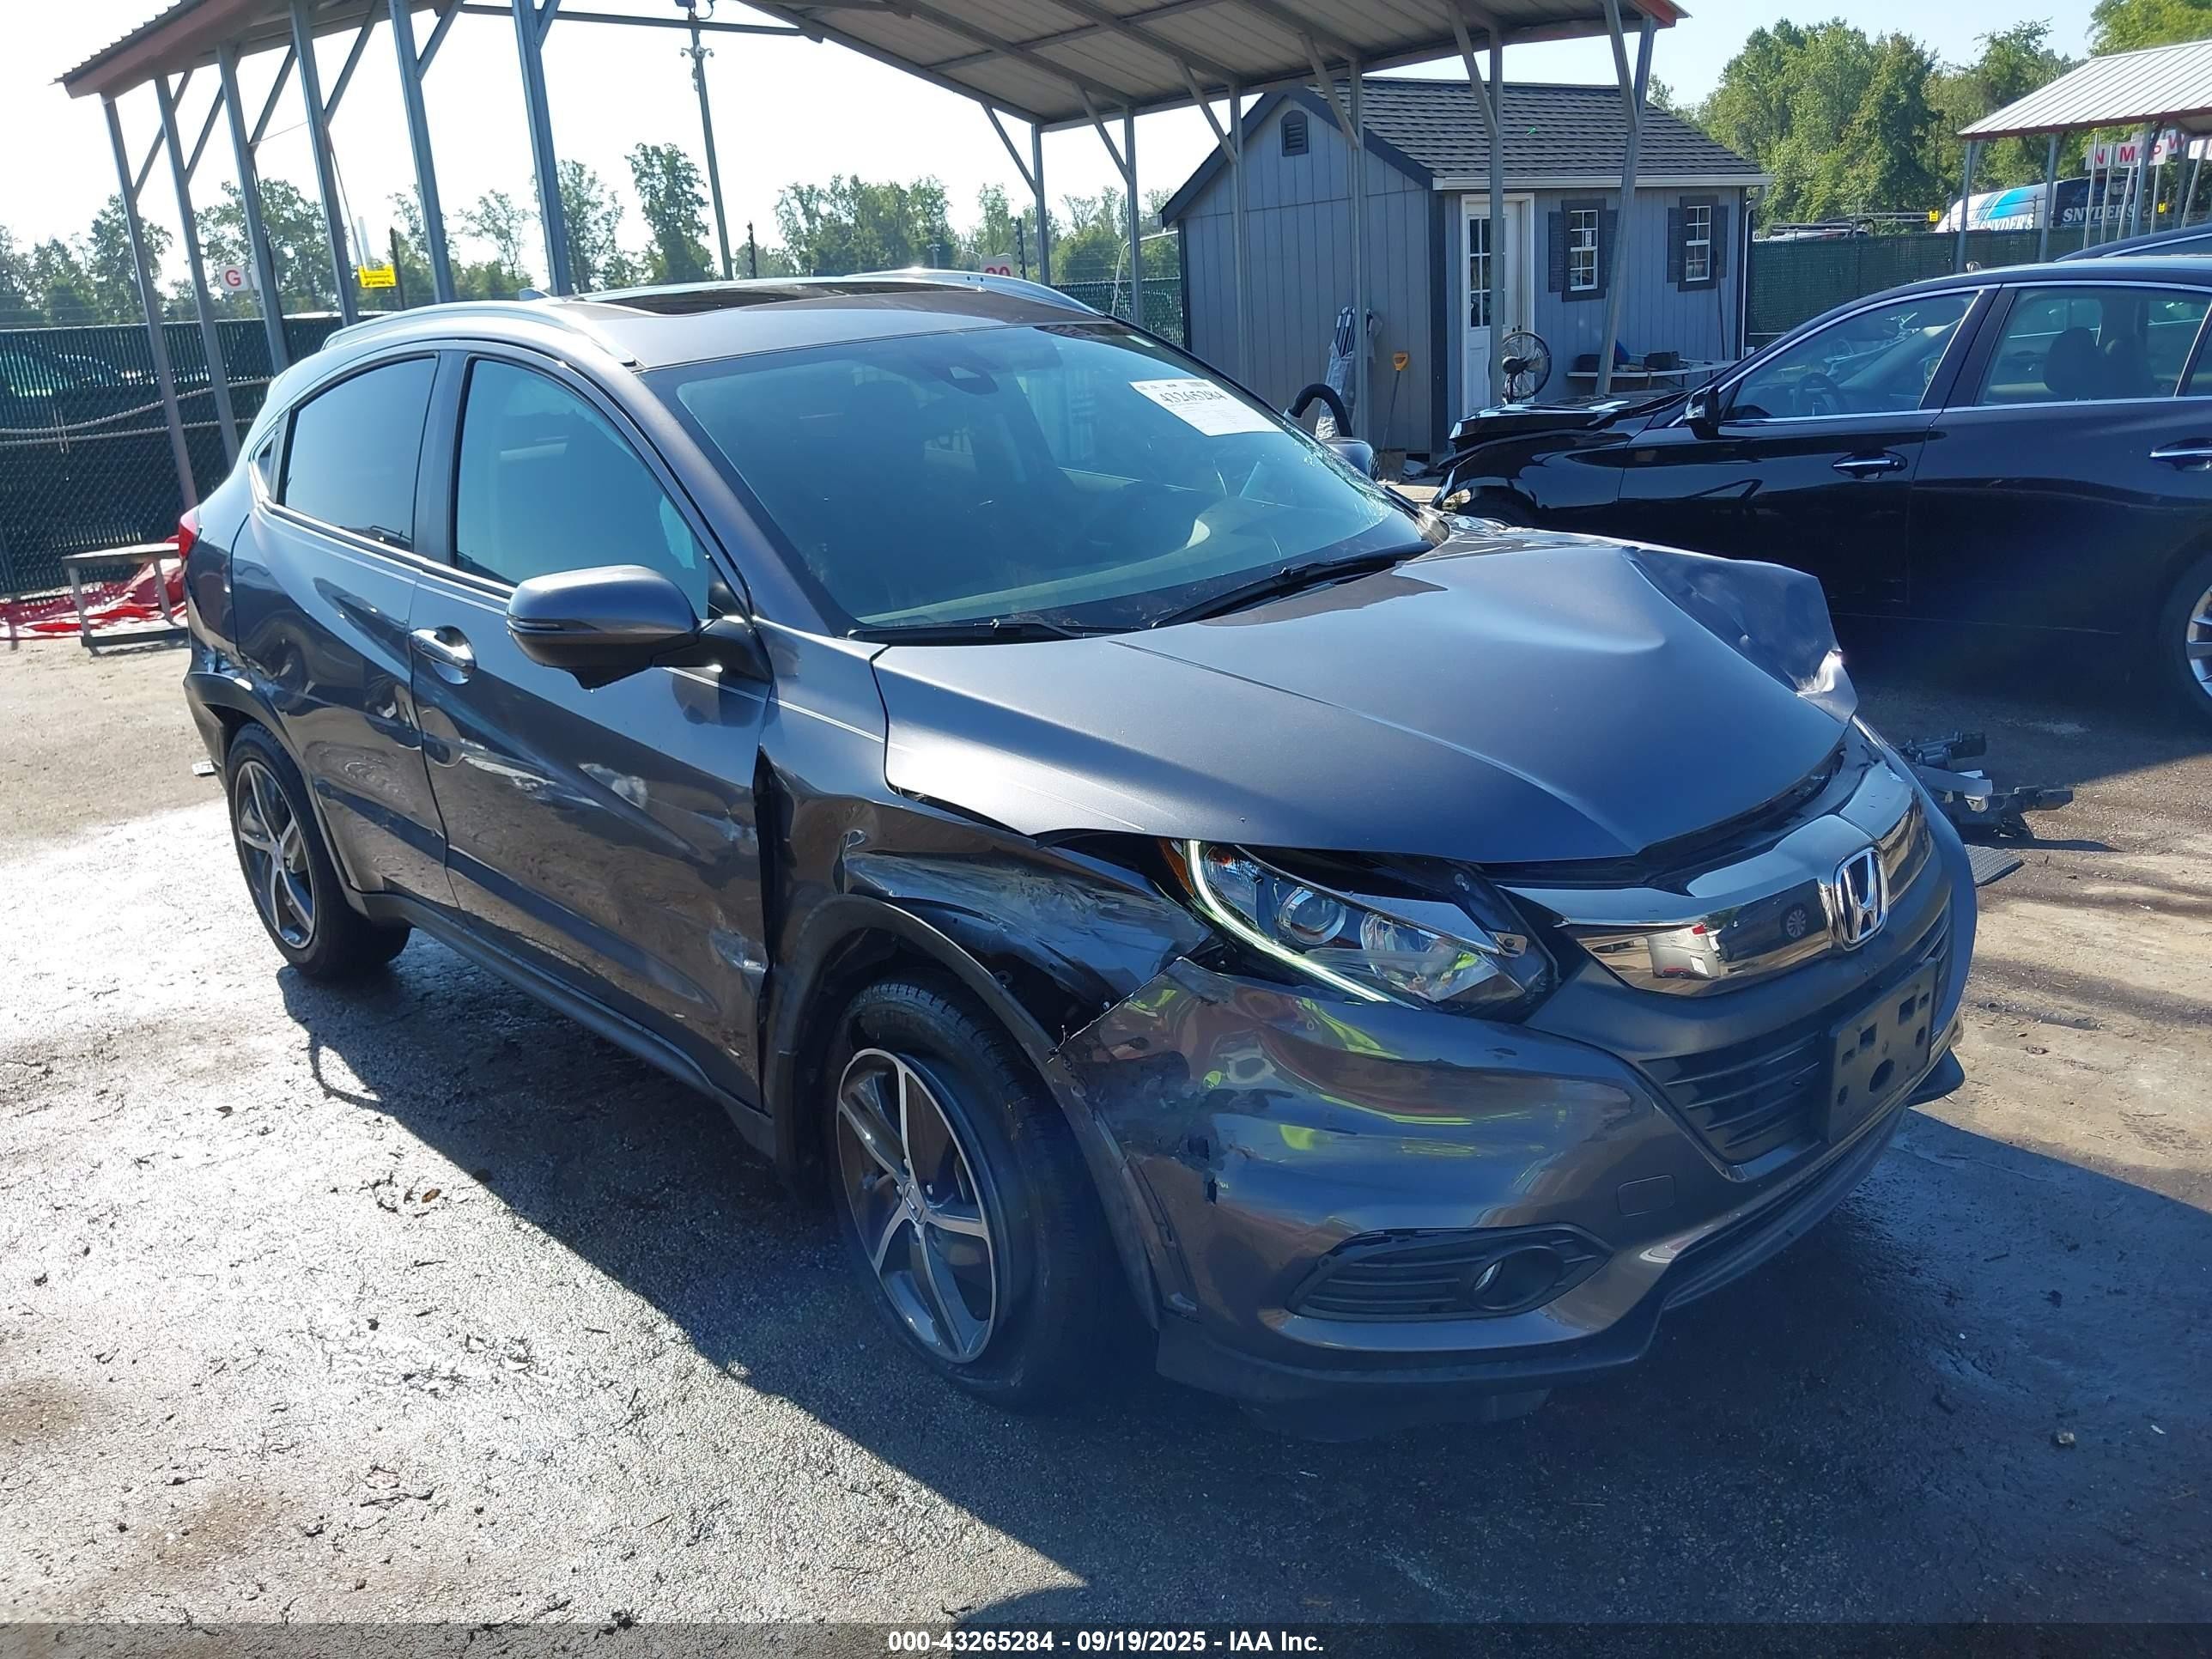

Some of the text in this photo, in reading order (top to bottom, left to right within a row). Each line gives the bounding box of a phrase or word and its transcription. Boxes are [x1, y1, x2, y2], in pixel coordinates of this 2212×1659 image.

[2119, 146, 2136, 162] M
[2063, 204, 2135, 222] SNYDERS
[225, 270, 241, 287] G
[1159, 391, 1228, 404] 43265284
